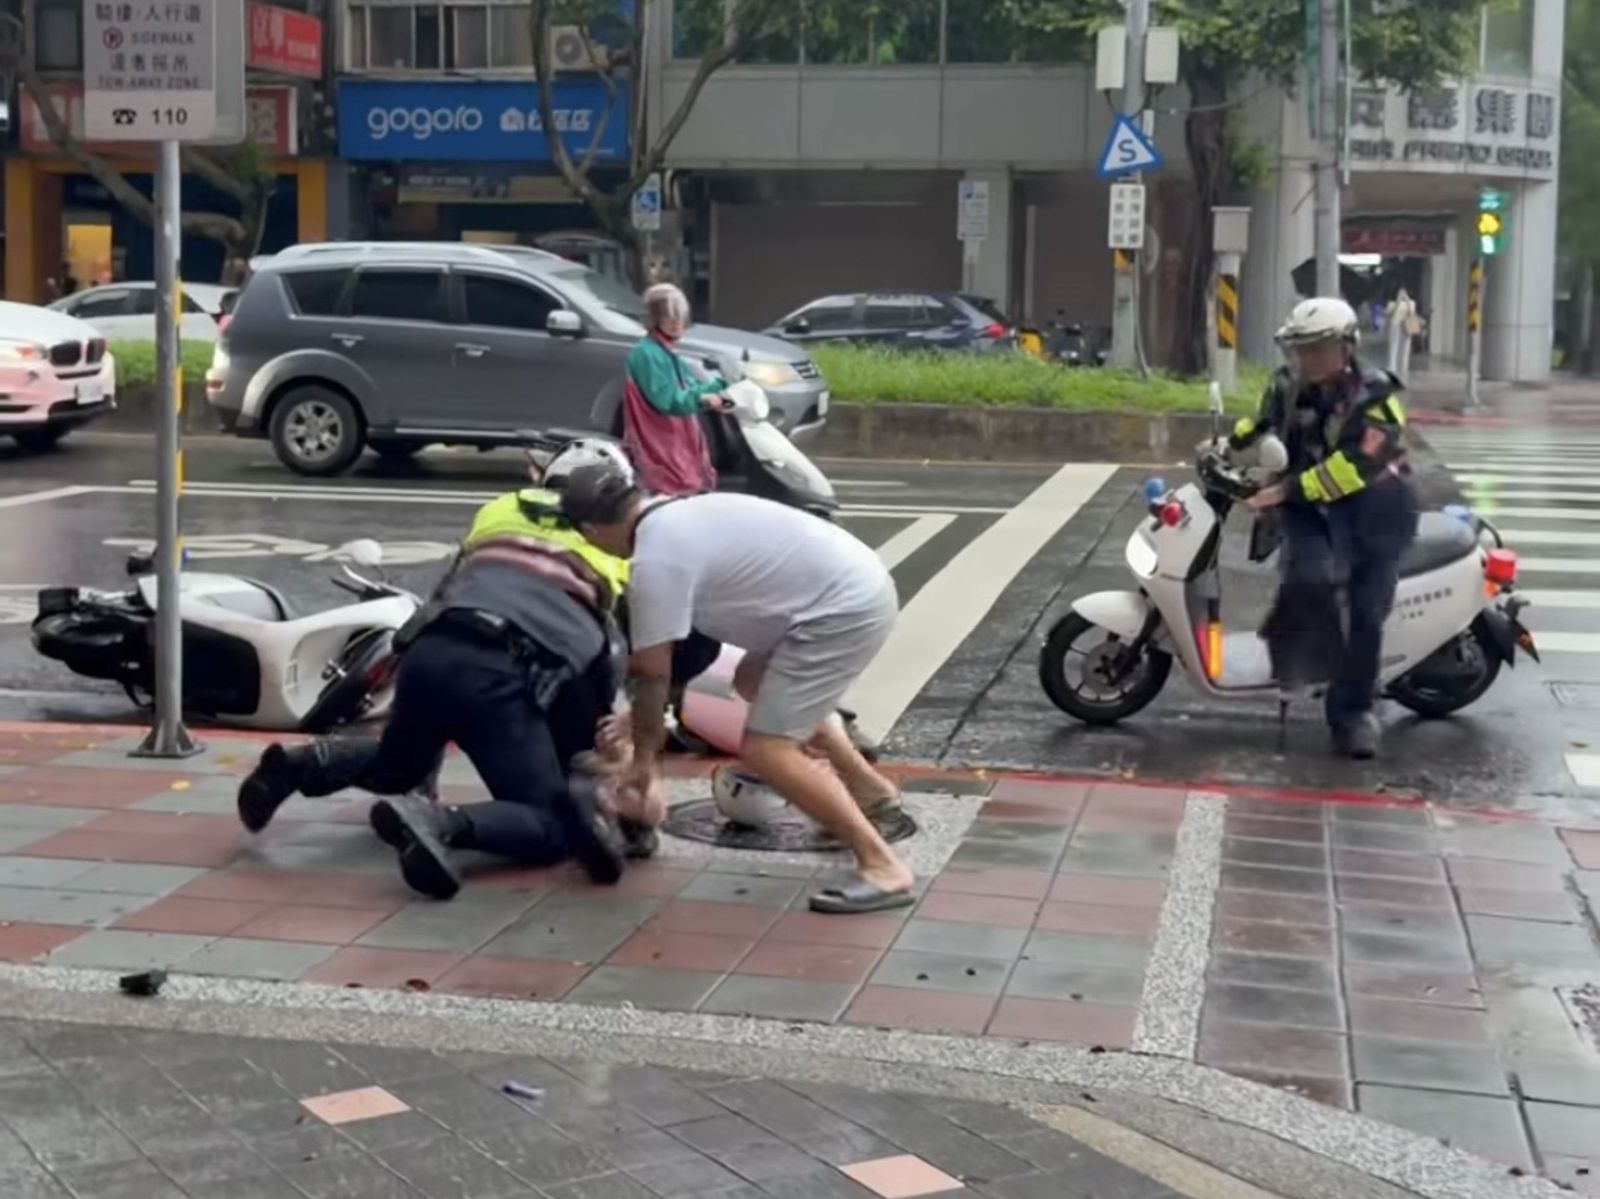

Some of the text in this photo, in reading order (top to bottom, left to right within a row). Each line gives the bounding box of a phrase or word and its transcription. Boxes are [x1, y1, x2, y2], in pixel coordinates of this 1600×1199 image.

[151, 108, 188, 125] 110
[367, 106, 483, 140] gogoro
[1117, 139, 1137, 163] S
